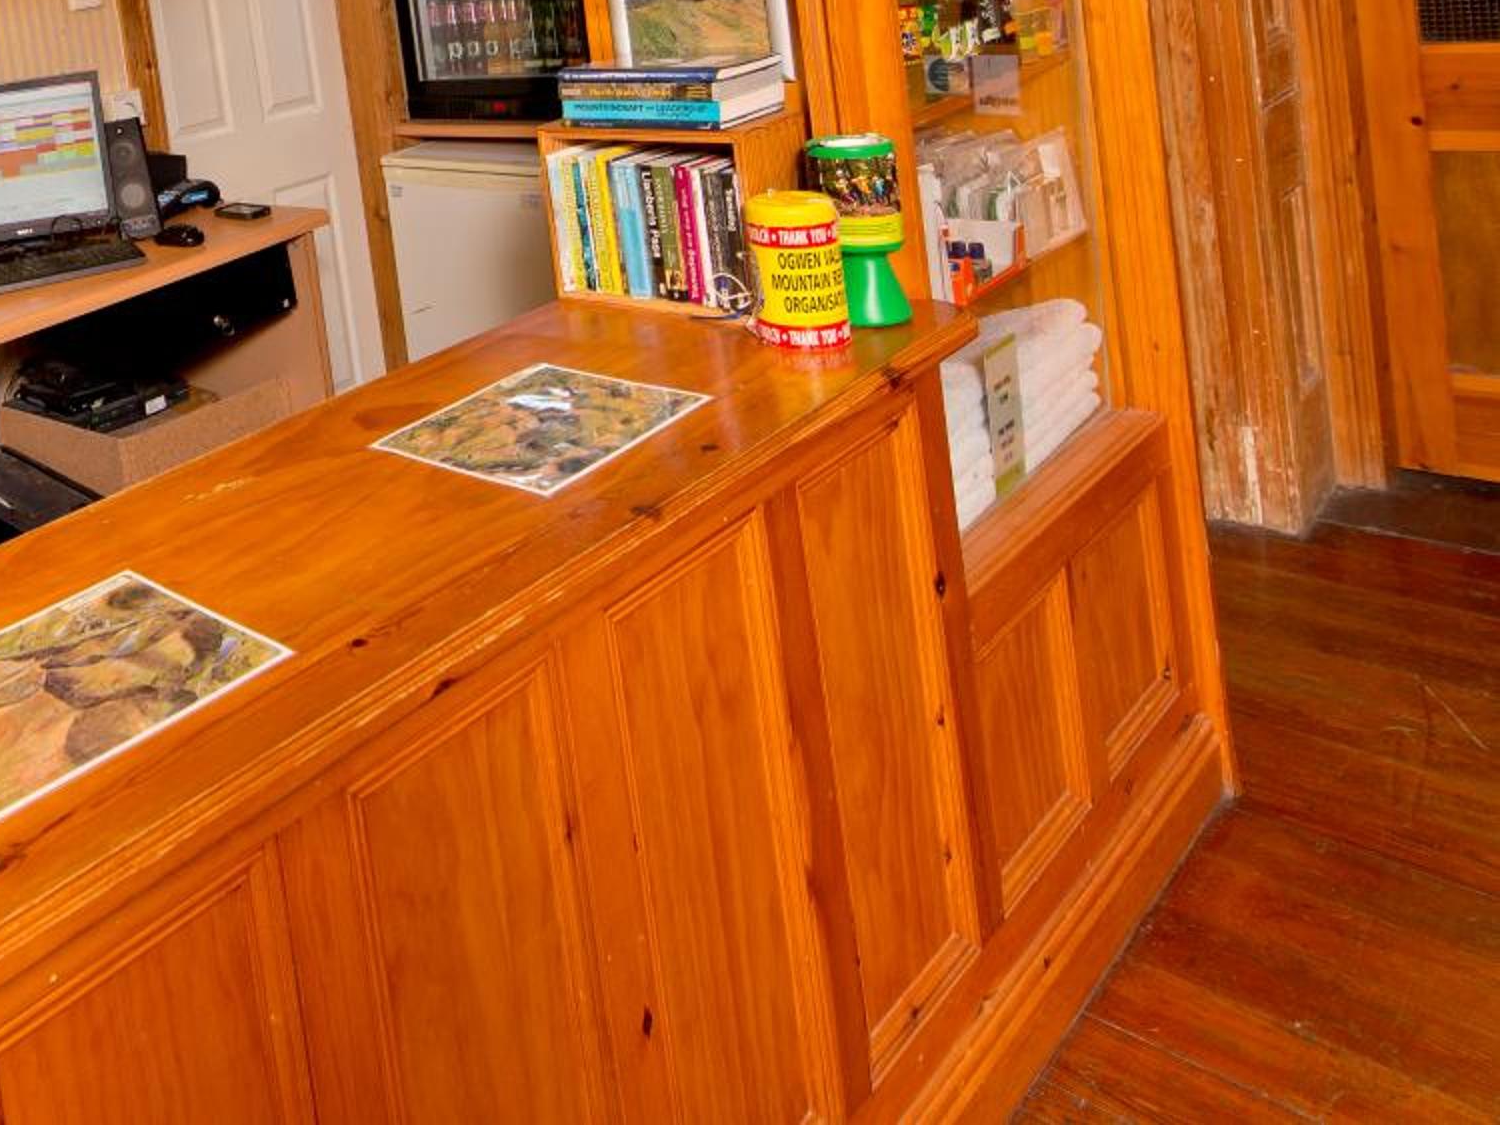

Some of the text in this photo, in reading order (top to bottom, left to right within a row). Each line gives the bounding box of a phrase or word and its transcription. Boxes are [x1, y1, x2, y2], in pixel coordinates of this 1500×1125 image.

[780, 229, 808, 245] THANK
[811, 227, 826, 243] YOU
[777, 252, 821, 270] OGWEN
[771, 273, 830, 291] MOUNTAIN
[788, 329, 818, 346] THANK
[820, 327, 838, 345] YOU
